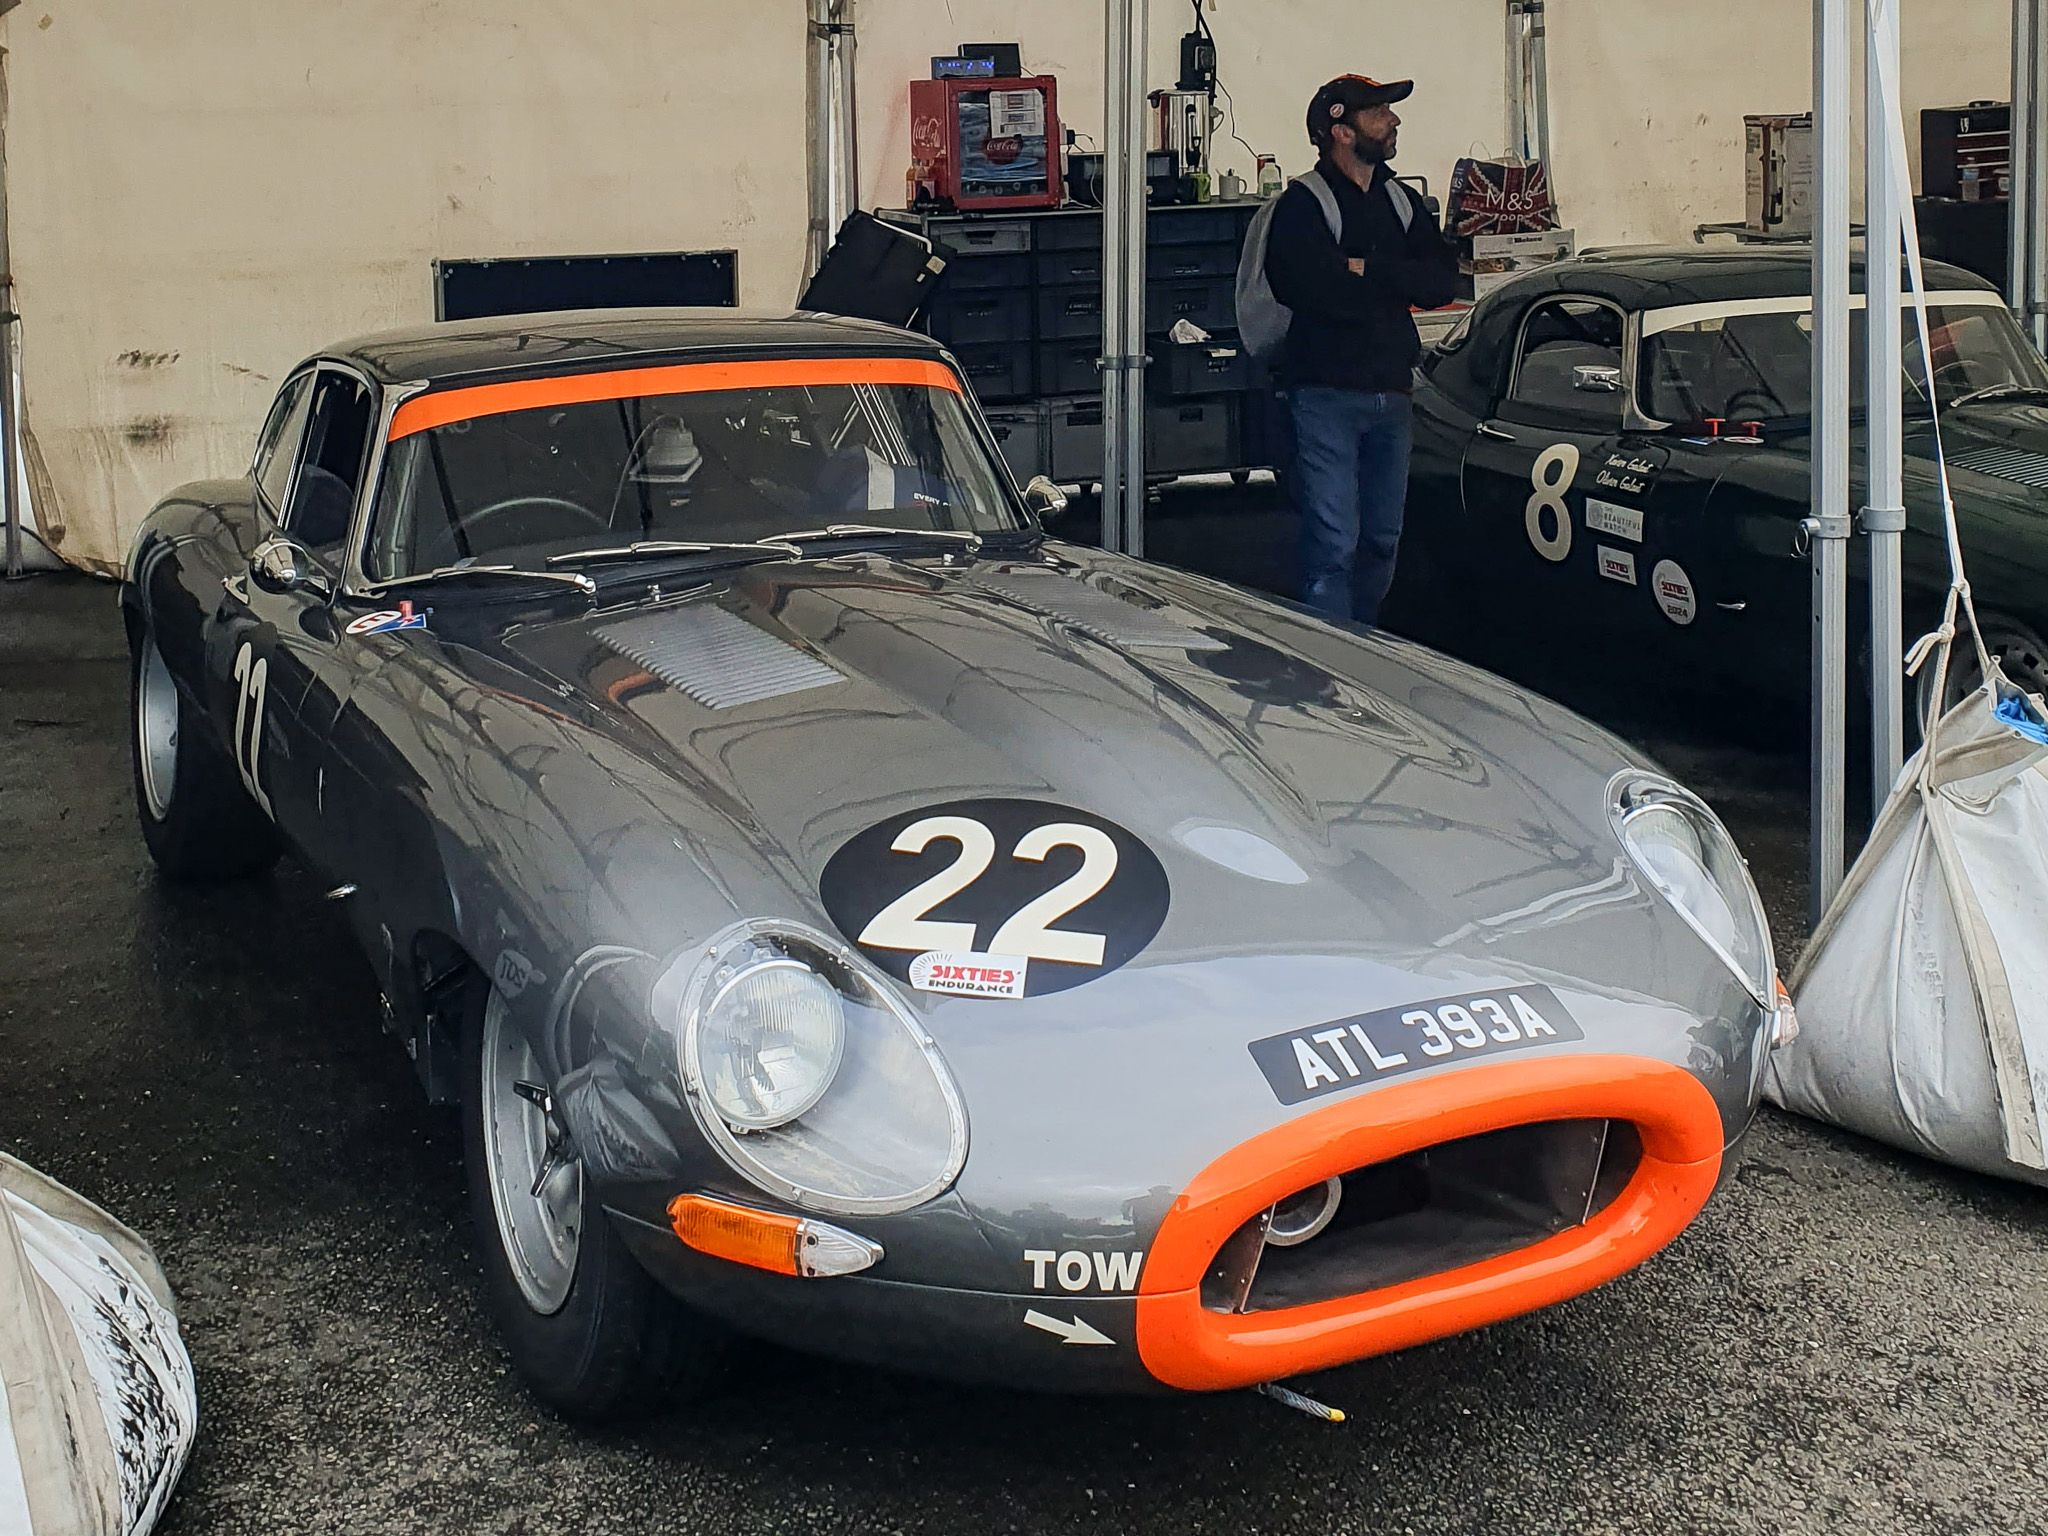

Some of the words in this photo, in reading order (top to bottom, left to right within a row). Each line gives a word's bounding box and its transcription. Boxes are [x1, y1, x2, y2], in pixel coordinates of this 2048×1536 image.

[1486, 189, 1534, 211] M&S
[1525, 443, 1580, 562] 8
[1604, 512, 1641, 531] BEAUTIFUL
[354, 613, 392, 629] E
[858, 816, 1118, 966] 22
[928, 980, 1013, 994] ENDURANCE
[1291, 1023, 1408, 1089] ATL
[1400, 993, 1557, 1057] 393A
[1024, 1249, 1143, 1292] TOW
